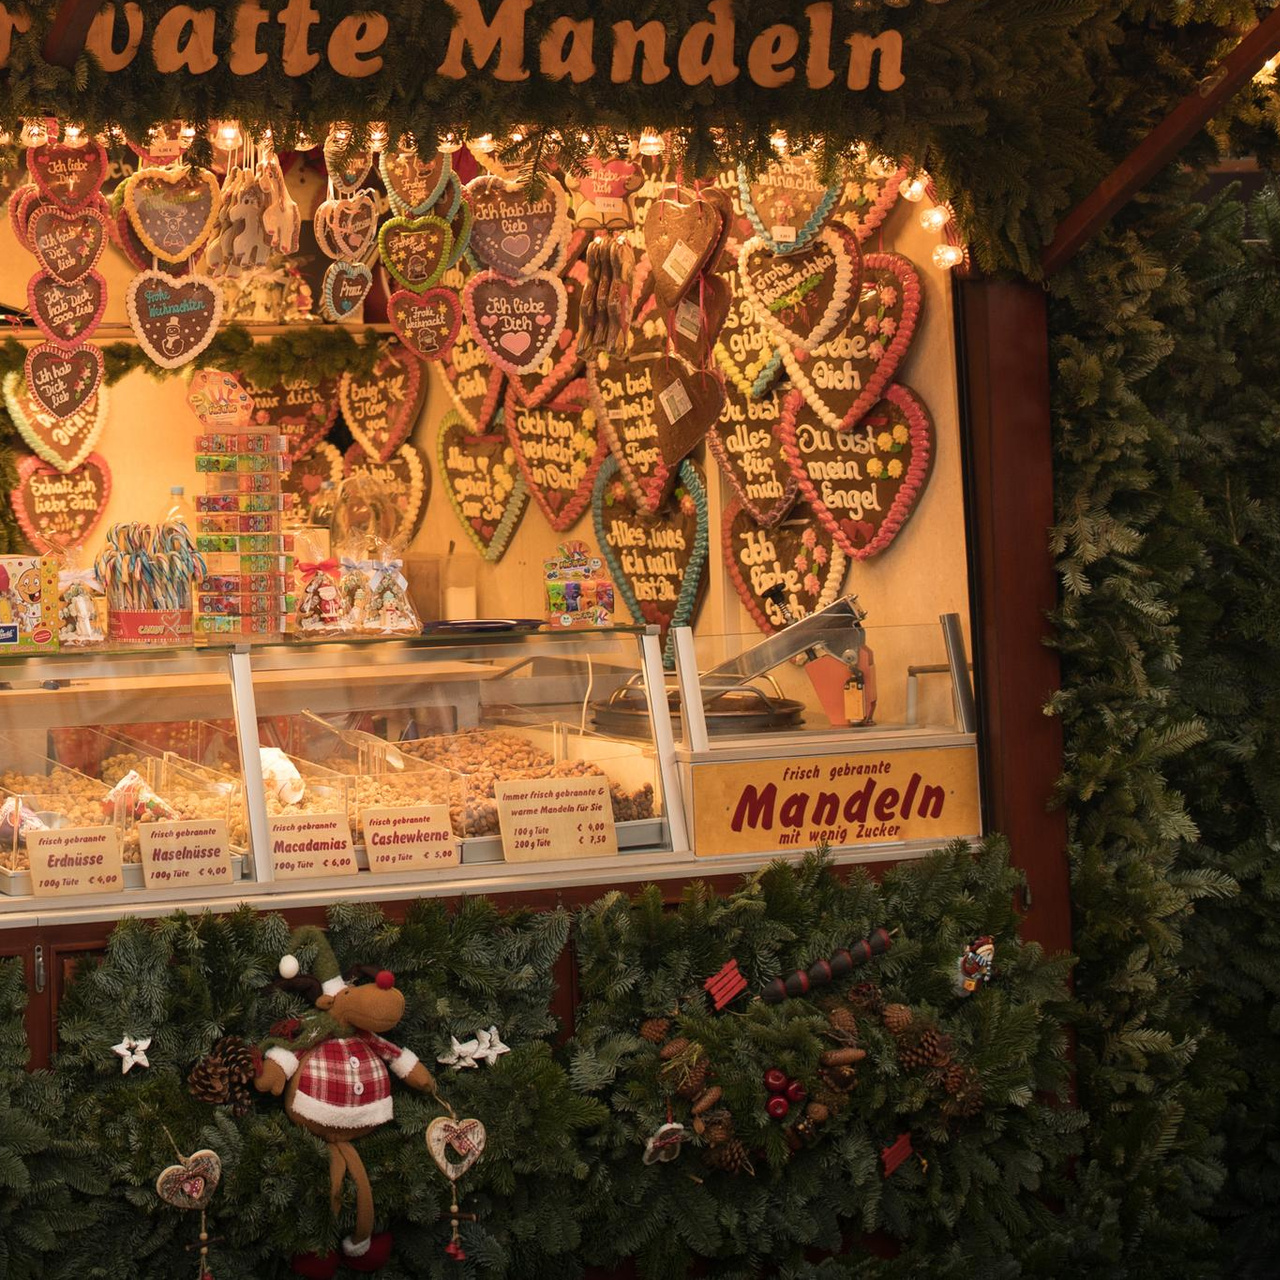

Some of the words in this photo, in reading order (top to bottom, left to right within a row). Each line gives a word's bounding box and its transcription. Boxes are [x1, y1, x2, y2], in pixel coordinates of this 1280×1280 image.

[48, 161, 66, 174] Ich
[67, 159, 89, 172] liebe
[476, 205, 497, 220] Ich
[499, 202, 524, 217] hab
[524, 200, 553, 217] Dich
[501, 219, 528, 234] lieb
[485, 297, 511, 314] Ich
[513, 297, 545, 314] liebe
[499, 315, 532, 331] Dich
[725, 425, 771, 453] alles
[795, 423, 833, 453] Du
[835, 426, 877, 455] bist
[807, 456, 863, 482] mein
[746, 476, 785, 500] mich
[34, 494, 68, 513] liebe
[821, 485, 882, 521] Engel
[740, 531, 777, 566] Ich
[783, 765, 820, 781] frisch
[829, 761, 892, 781] gebrannte
[502, 792, 529, 801] Immer
[529, 789, 554, 799] frisch
[555, 787, 596, 800] gebrannte
[511, 807, 539, 816] warme
[540, 804, 575, 815] Mandeln
[590, 802, 603, 812] Sie
[731, 773, 946, 833] Mandeln
[273, 823, 296, 832] frisch
[297, 821, 338, 833] gebrannte
[369, 817, 391, 827] frisch
[392, 815, 431, 827] gebrannte
[38, 837, 63, 846] frisch
[63, 834, 107, 846] gebrannte
[150, 830, 174, 839] frisch
[175, 827, 217, 839] gebrannte
[371, 829, 450, 847] Cashewkerne
[779, 829, 801, 846] mit
[809, 826, 848, 845] wenig
[856, 823, 901, 840] Zucker
[152, 845, 222, 862] Haselnüsse
[273, 837, 348, 854] Macadamias
[47, 852, 105, 869] Erdnüsse
[274, 861, 296, 871] 100g
[297, 859, 314, 869] Tüte
[331, 857, 351, 867] 6,00
[375, 854, 391, 863] 100
[397, 852, 413, 862] Tüte
[434, 849, 453, 859] 5,00
[38, 878, 60, 889] 100g
[62, 877, 80, 886] Tüte
[97, 874, 118, 884] 4,00
[150, 871, 172, 881] 100g
[173, 869, 190, 878] Tüte
[206, 866, 227, 876] 4,00
